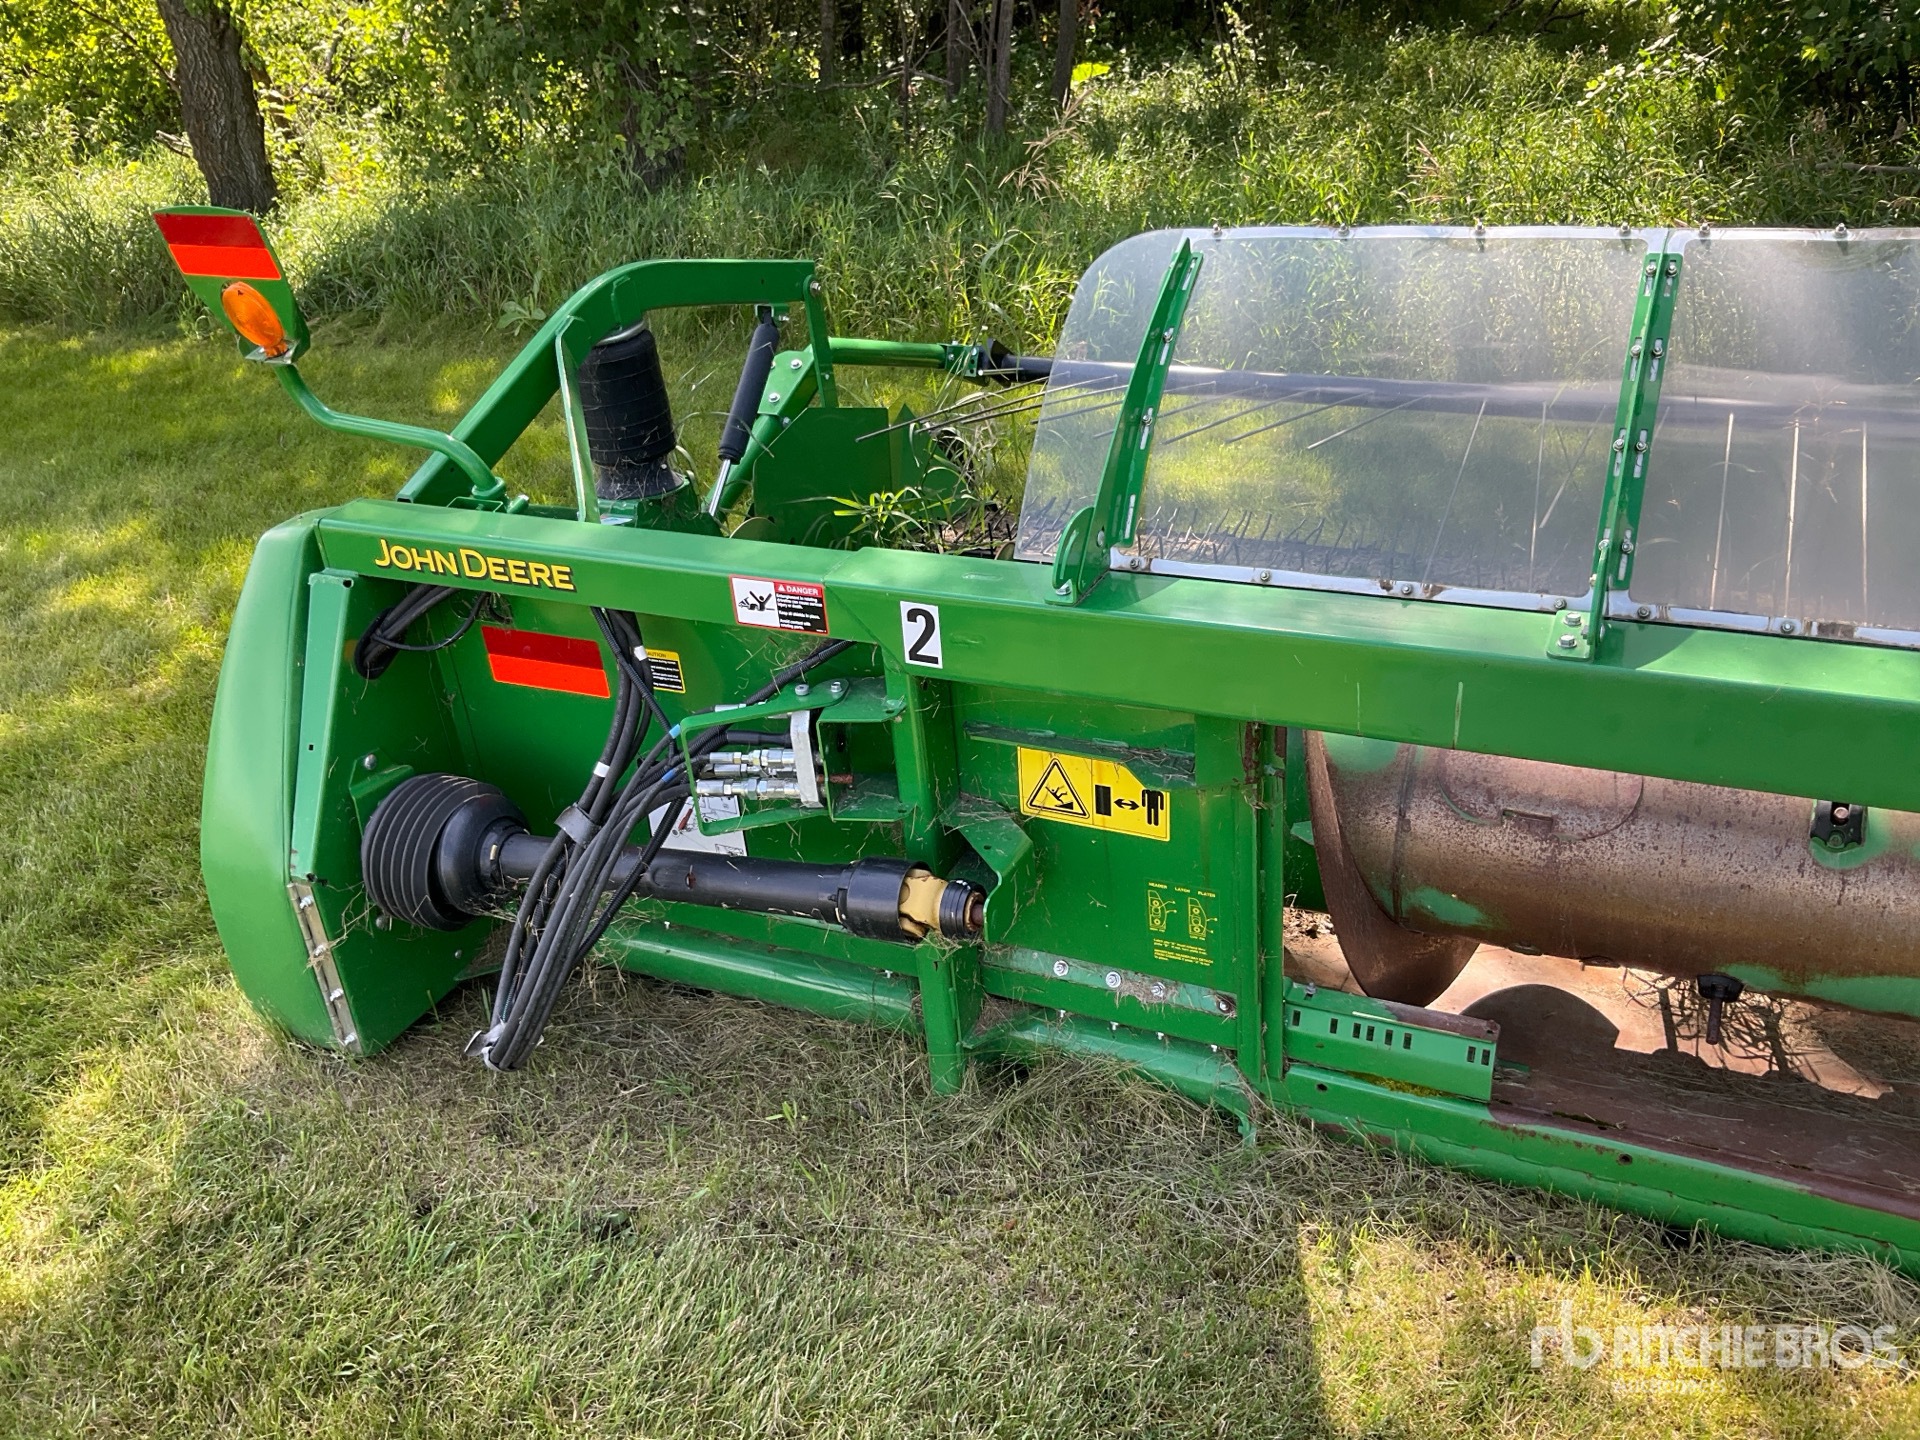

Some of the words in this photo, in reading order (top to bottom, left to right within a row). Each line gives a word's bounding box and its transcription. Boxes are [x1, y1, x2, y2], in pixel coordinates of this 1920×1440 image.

[374, 538, 459, 577] JOHN
[459, 547, 576, 591] DEERE
[786, 585, 819, 596] DANGER
[906, 607, 939, 665] 2
